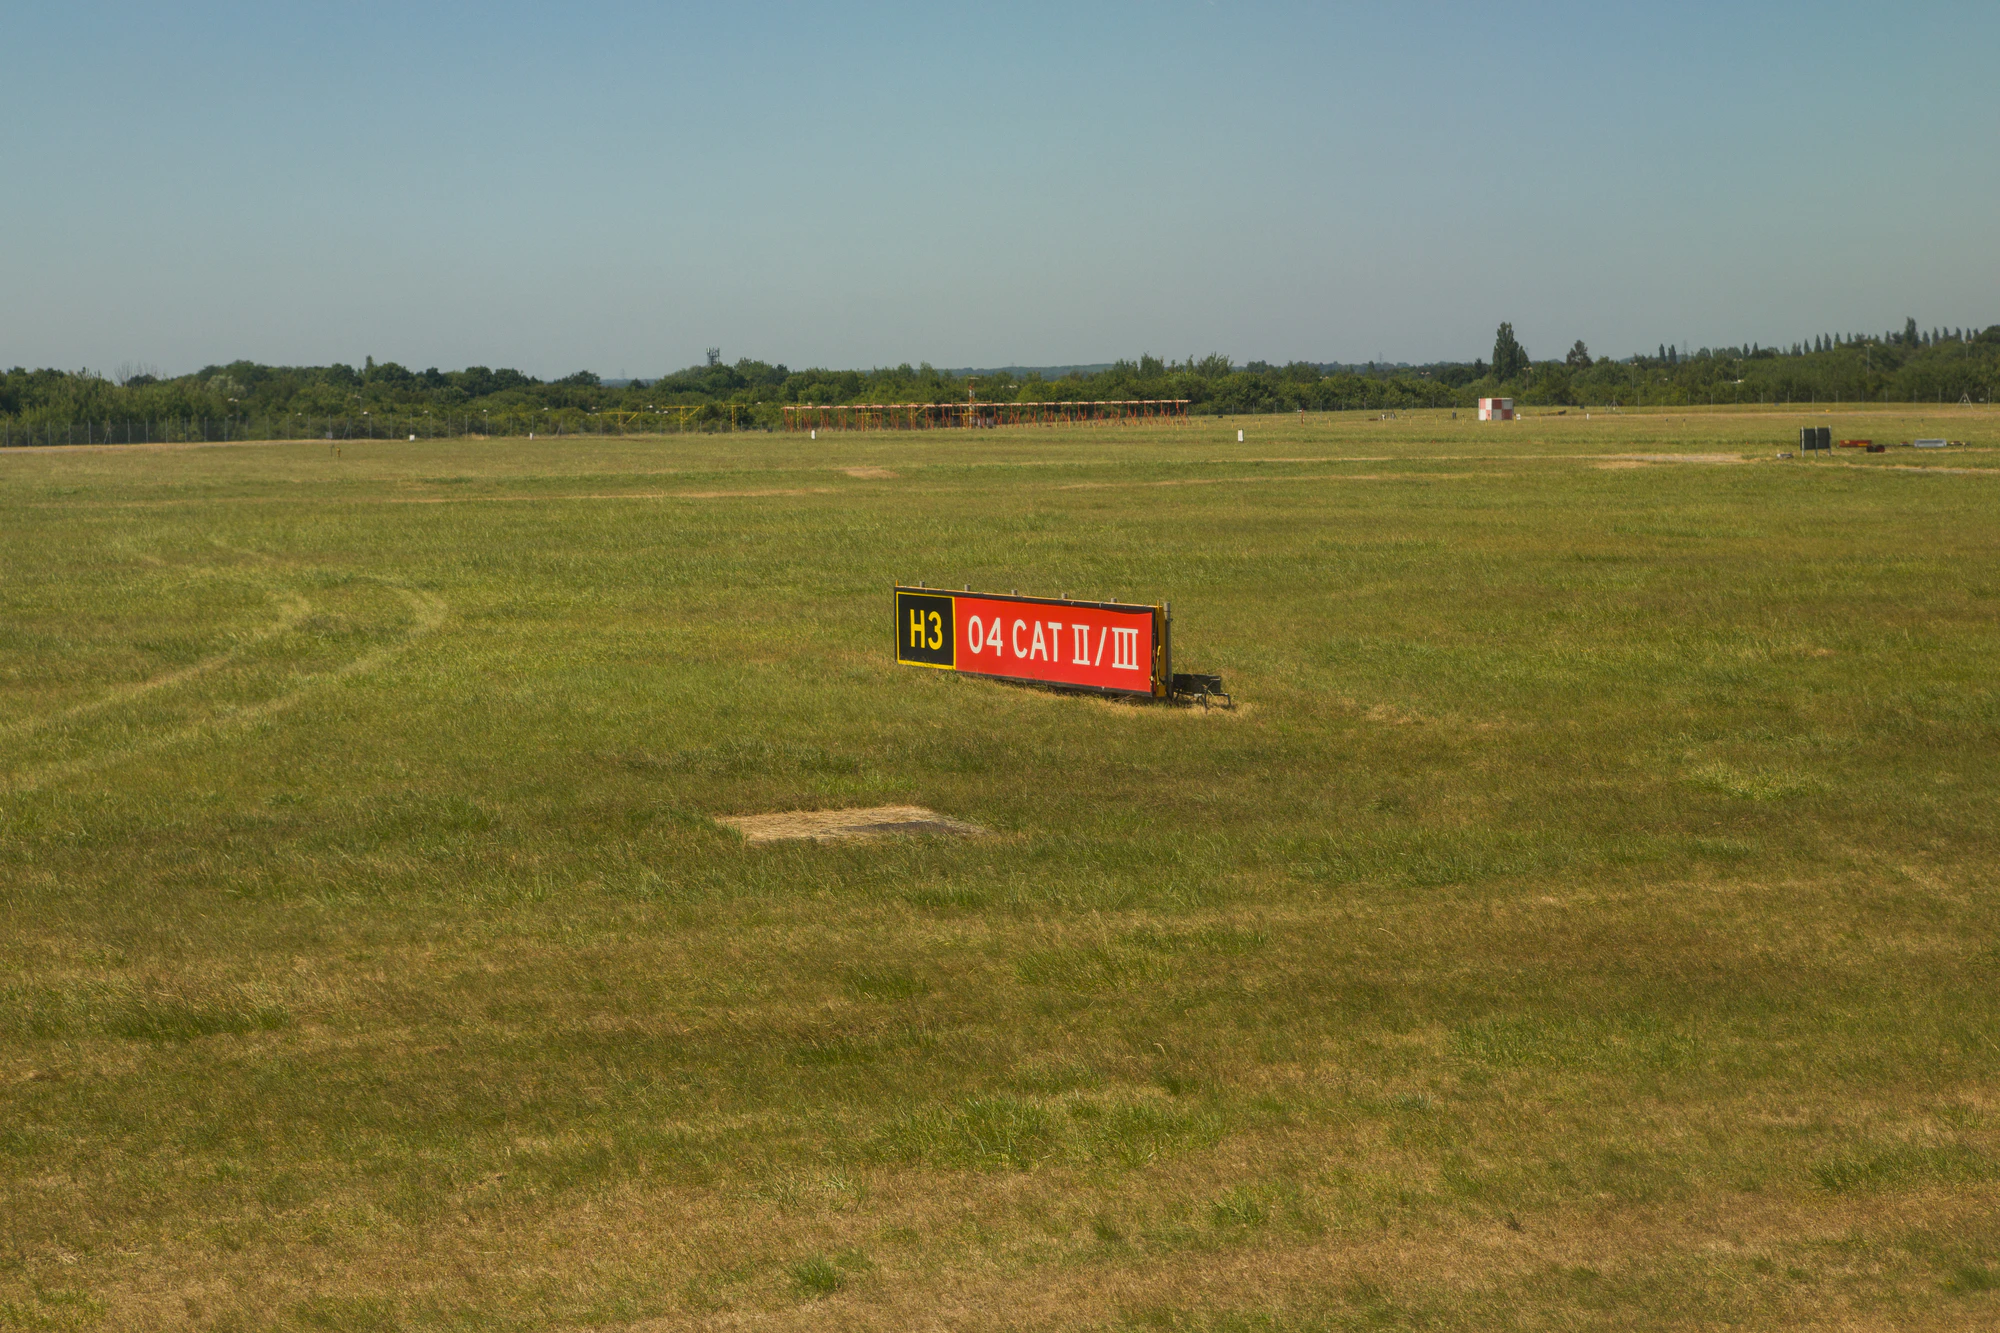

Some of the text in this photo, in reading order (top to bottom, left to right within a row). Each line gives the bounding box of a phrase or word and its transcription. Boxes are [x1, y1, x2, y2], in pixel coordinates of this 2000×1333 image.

[910, 608, 943, 650] H3
[968, 615, 1004, 657] 04
[1012, 619, 1062, 662] CAT
